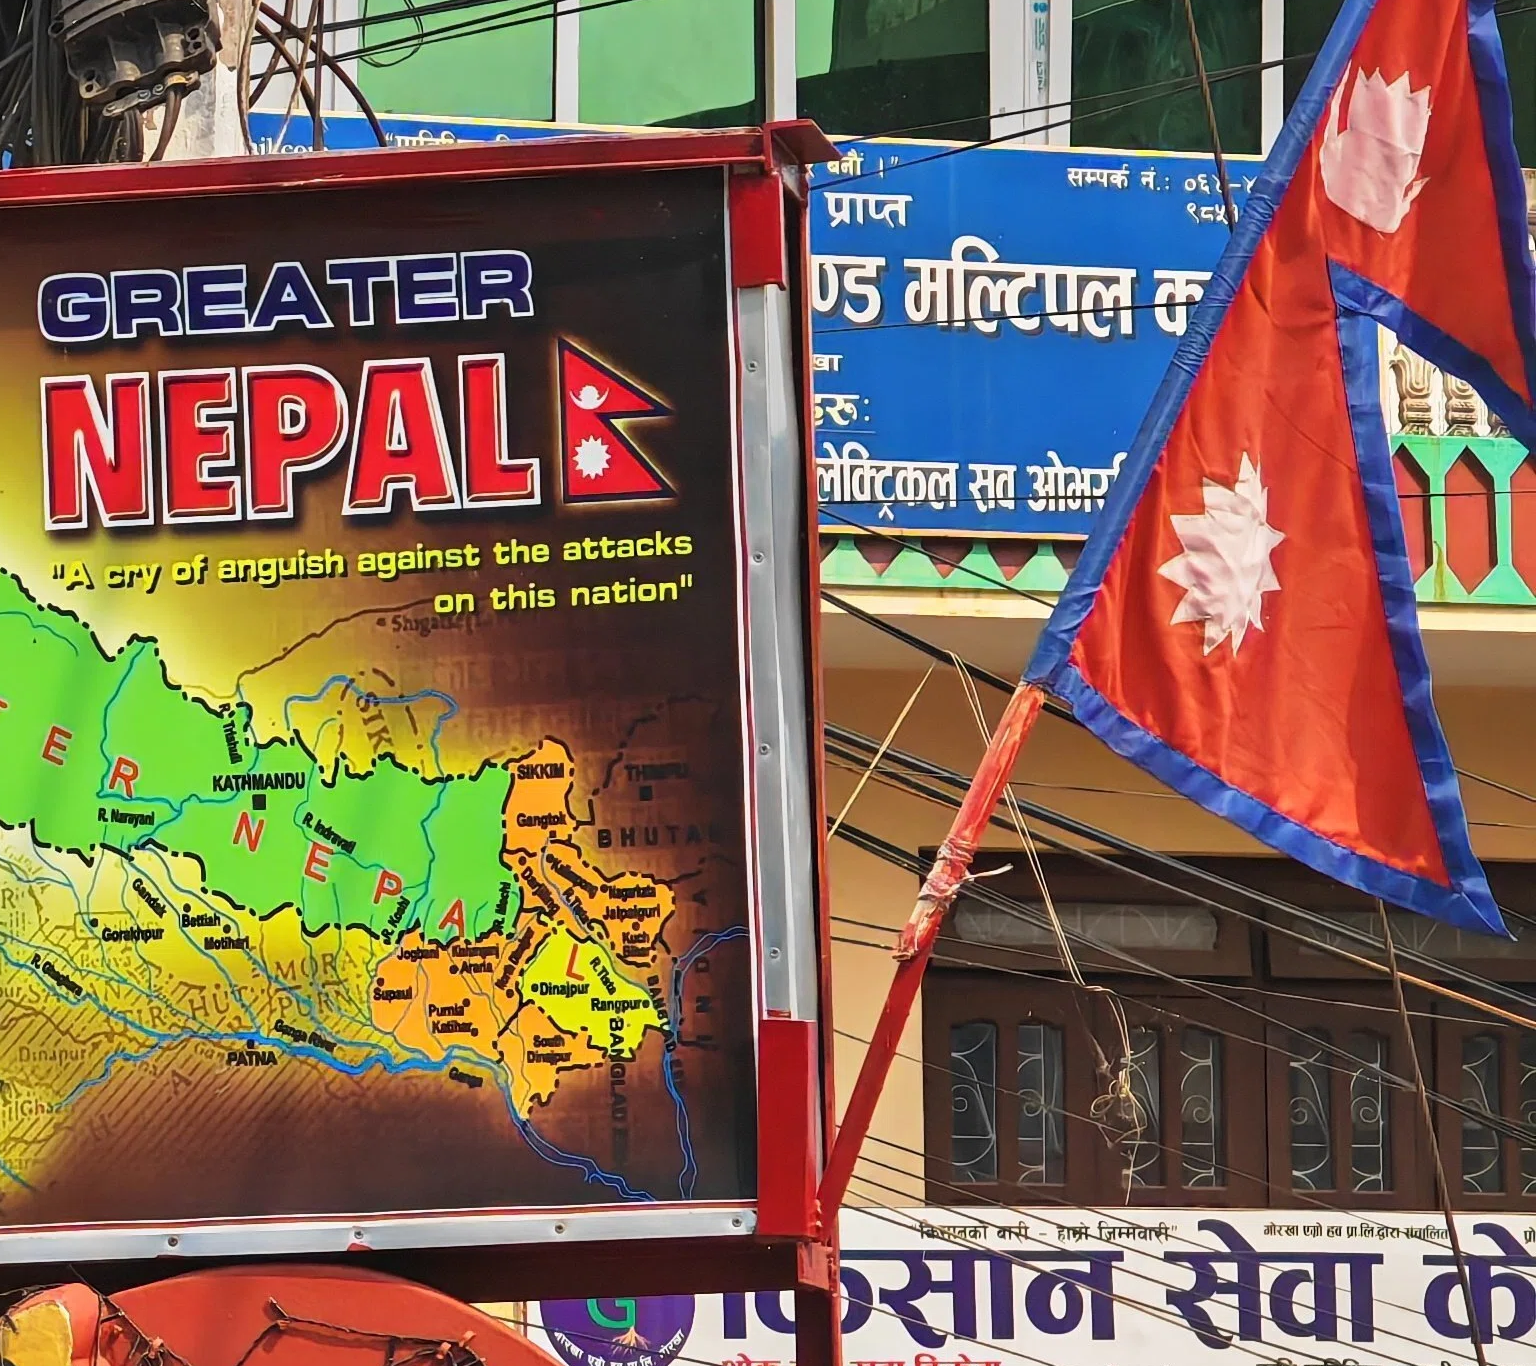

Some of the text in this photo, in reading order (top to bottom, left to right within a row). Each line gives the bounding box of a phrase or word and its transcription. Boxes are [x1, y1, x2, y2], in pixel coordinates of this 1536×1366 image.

[1066, 163, 1131, 190] सम्पर्क
[823, 191, 913, 228] प्राप्त
[36, 248, 536, 343] GREATER
[903, 235, 1137, 339] मल्टिपल
[39, 351, 542, 532] NEPAL
[104, 561, 161, 594] cry
[172, 554, 208, 585] of
[218, 548, 344, 588] anguish
[357, 542, 481, 579] against
[496, 539, 550, 566] the
[564, 530, 693, 562] attacks
[434, 573, 694, 615] on this nation"
[212, 772, 307, 792] KATHMANDU
[517, 762, 564, 781] SIKKIM
[516, 811, 567, 830] Gangtok
[539, 981, 591, 999] Dinajpur
[590, 997, 644, 1014] Rangpur
[227, 1050, 279, 1067] PATNA
[1163, 1218, 1384, 1350] सेवा
